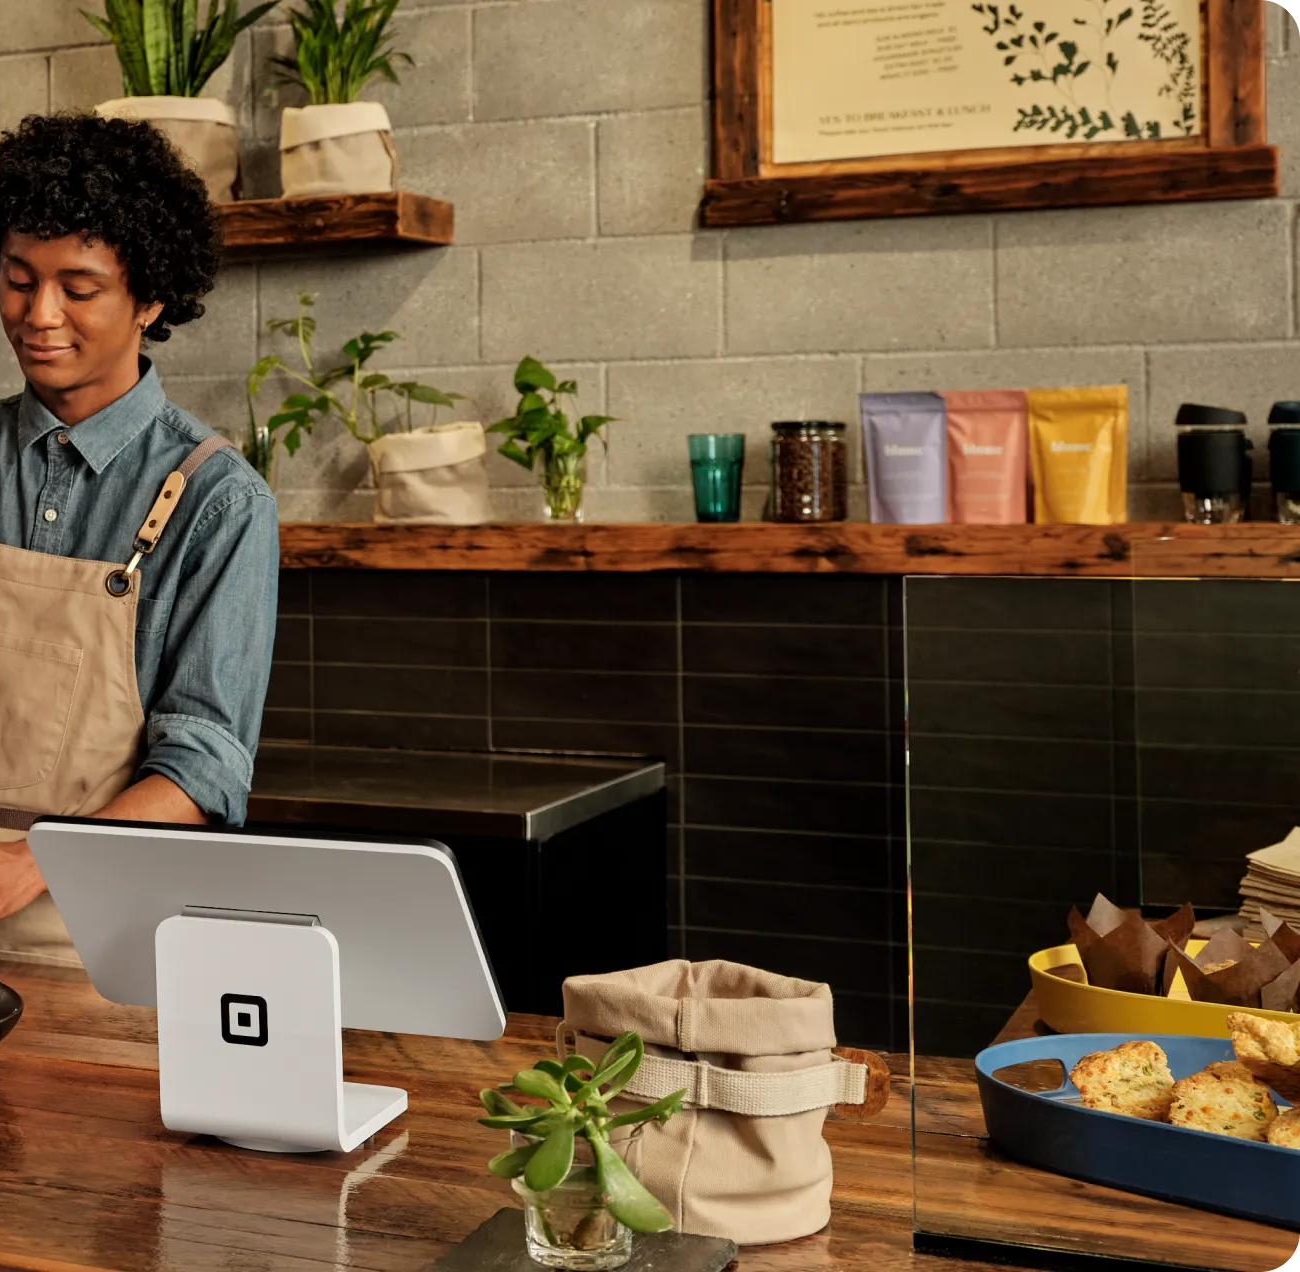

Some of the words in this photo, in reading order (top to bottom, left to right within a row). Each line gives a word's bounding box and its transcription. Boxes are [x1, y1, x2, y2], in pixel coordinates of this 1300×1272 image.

[845, 113, 861, 123] TO
[863, 108, 932, 122] BREAKFAST
[937, 107, 945, 117] &
[947, 103, 992, 116] LUNCH
